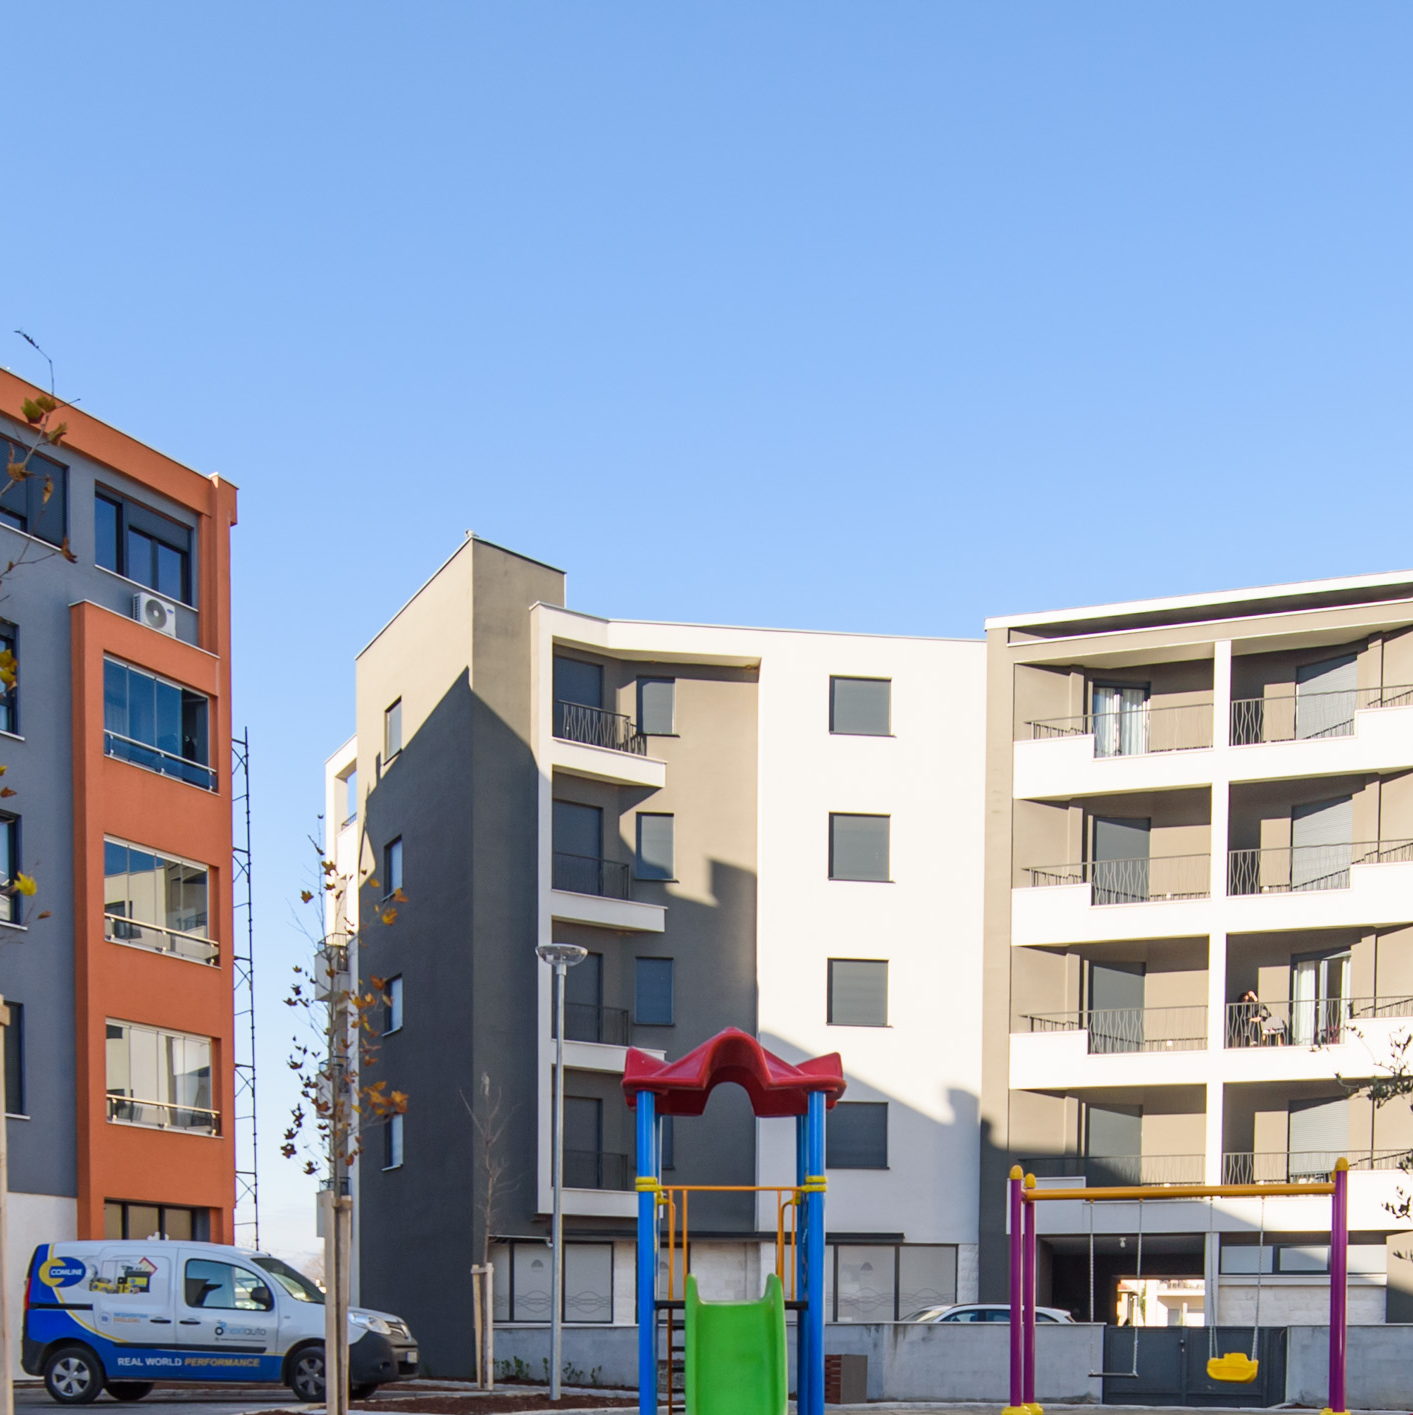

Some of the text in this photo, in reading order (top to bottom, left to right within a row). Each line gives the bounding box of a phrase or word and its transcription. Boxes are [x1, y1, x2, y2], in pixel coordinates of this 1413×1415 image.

[50, 1268, 83, 1276] COMLINE
[117, 1357, 260, 1367] REAL WORLD PERFORMANCE
